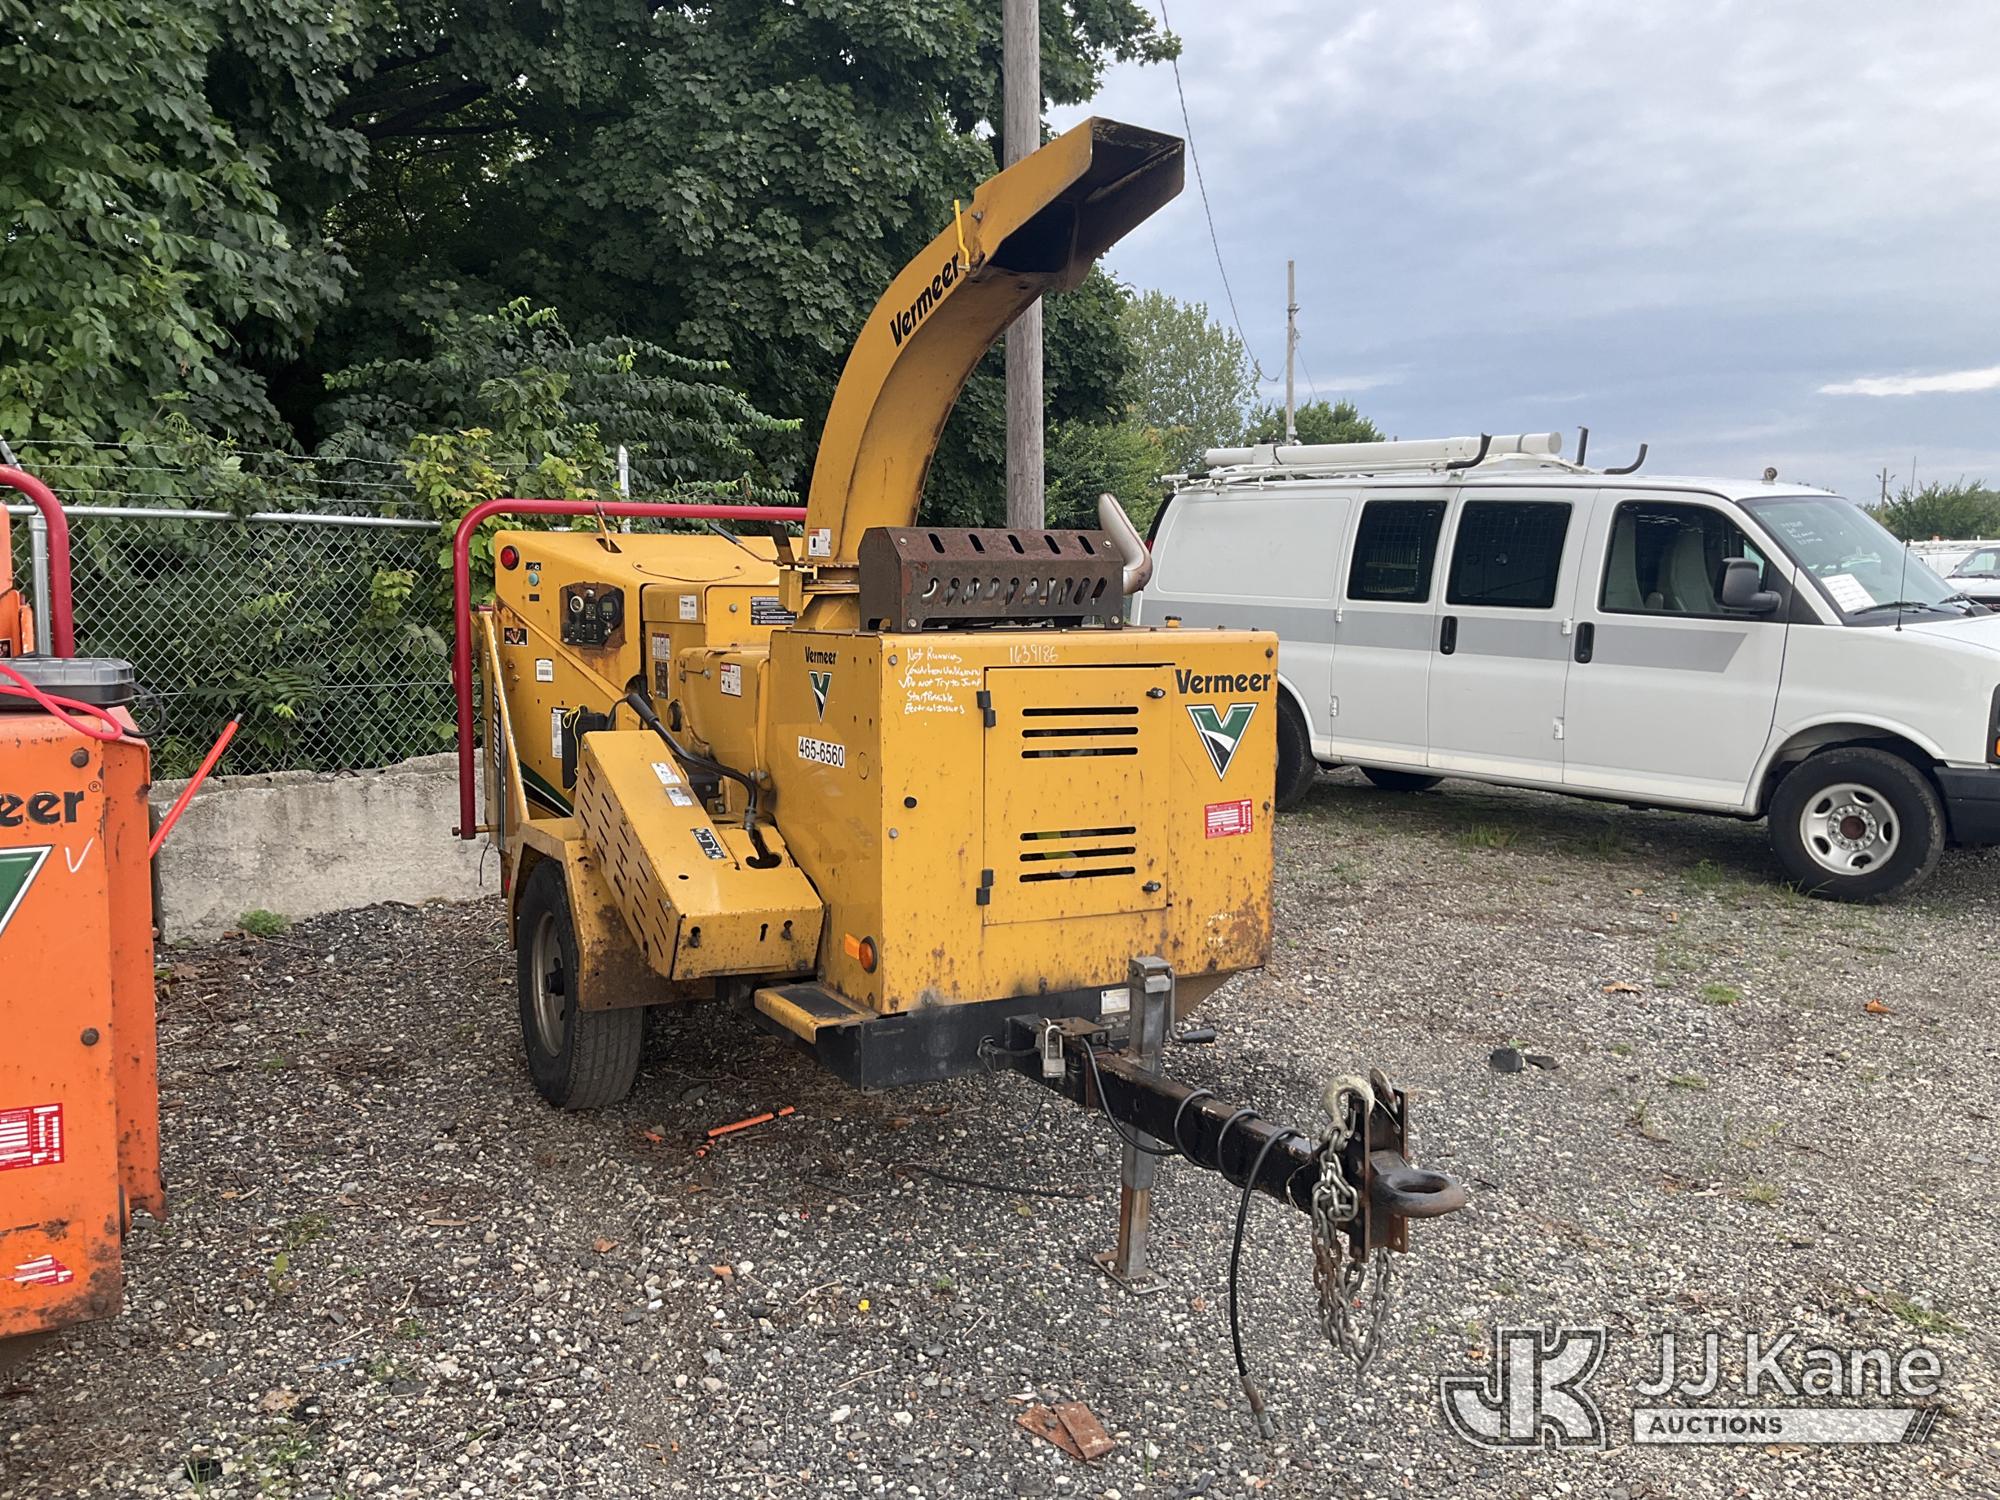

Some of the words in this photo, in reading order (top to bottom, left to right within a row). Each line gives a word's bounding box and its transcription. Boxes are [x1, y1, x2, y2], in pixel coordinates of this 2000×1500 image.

[890, 252, 958, 347] Vermeer
[804, 646, 836, 664] Vermeer
[1009, 644, 1058, 664] 1639186
[1175, 669, 1271, 694] Vermeer
[799, 738, 844, 767] 465-6560
